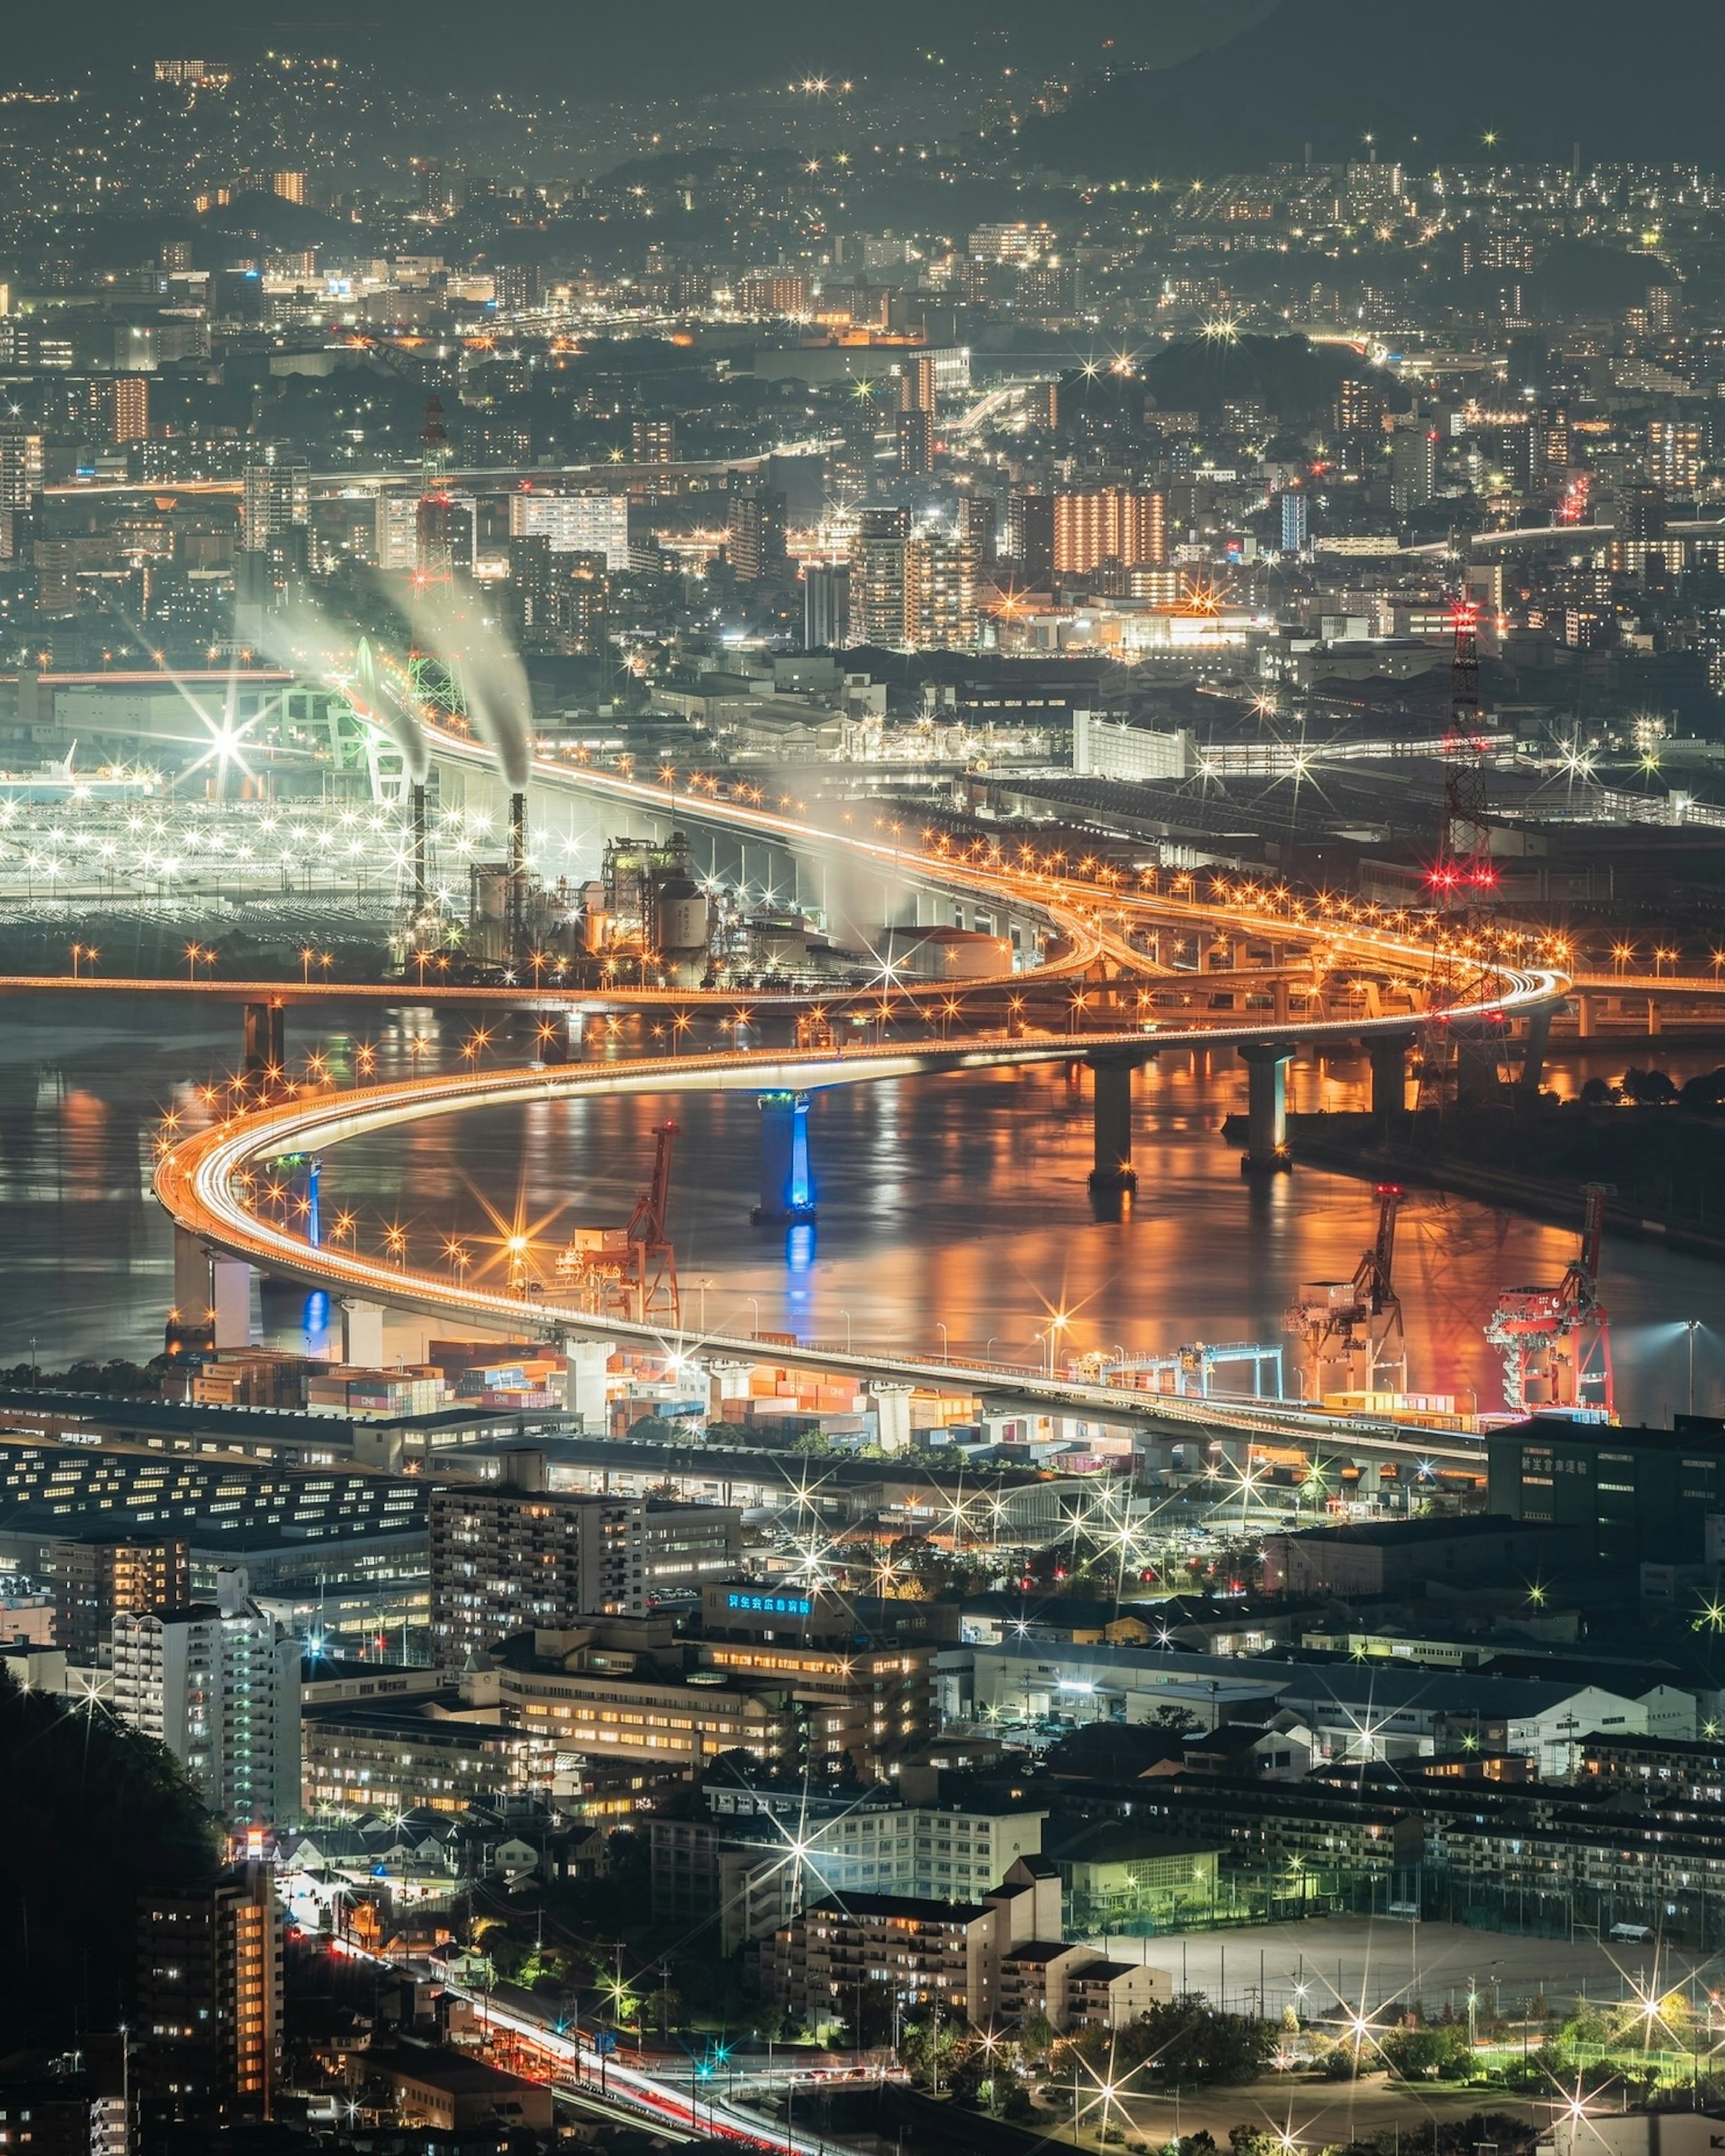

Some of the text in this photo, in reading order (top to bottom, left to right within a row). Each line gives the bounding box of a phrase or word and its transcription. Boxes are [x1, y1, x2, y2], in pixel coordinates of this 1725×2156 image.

[830, 1388, 845, 1396] ONE
[361, 1397, 376, 1406] ONE
[494, 1394, 509, 1403] ONE
[1106, 1457, 1120, 1466] ONE
[729, 1594, 809, 1614] 済生会広島病院
